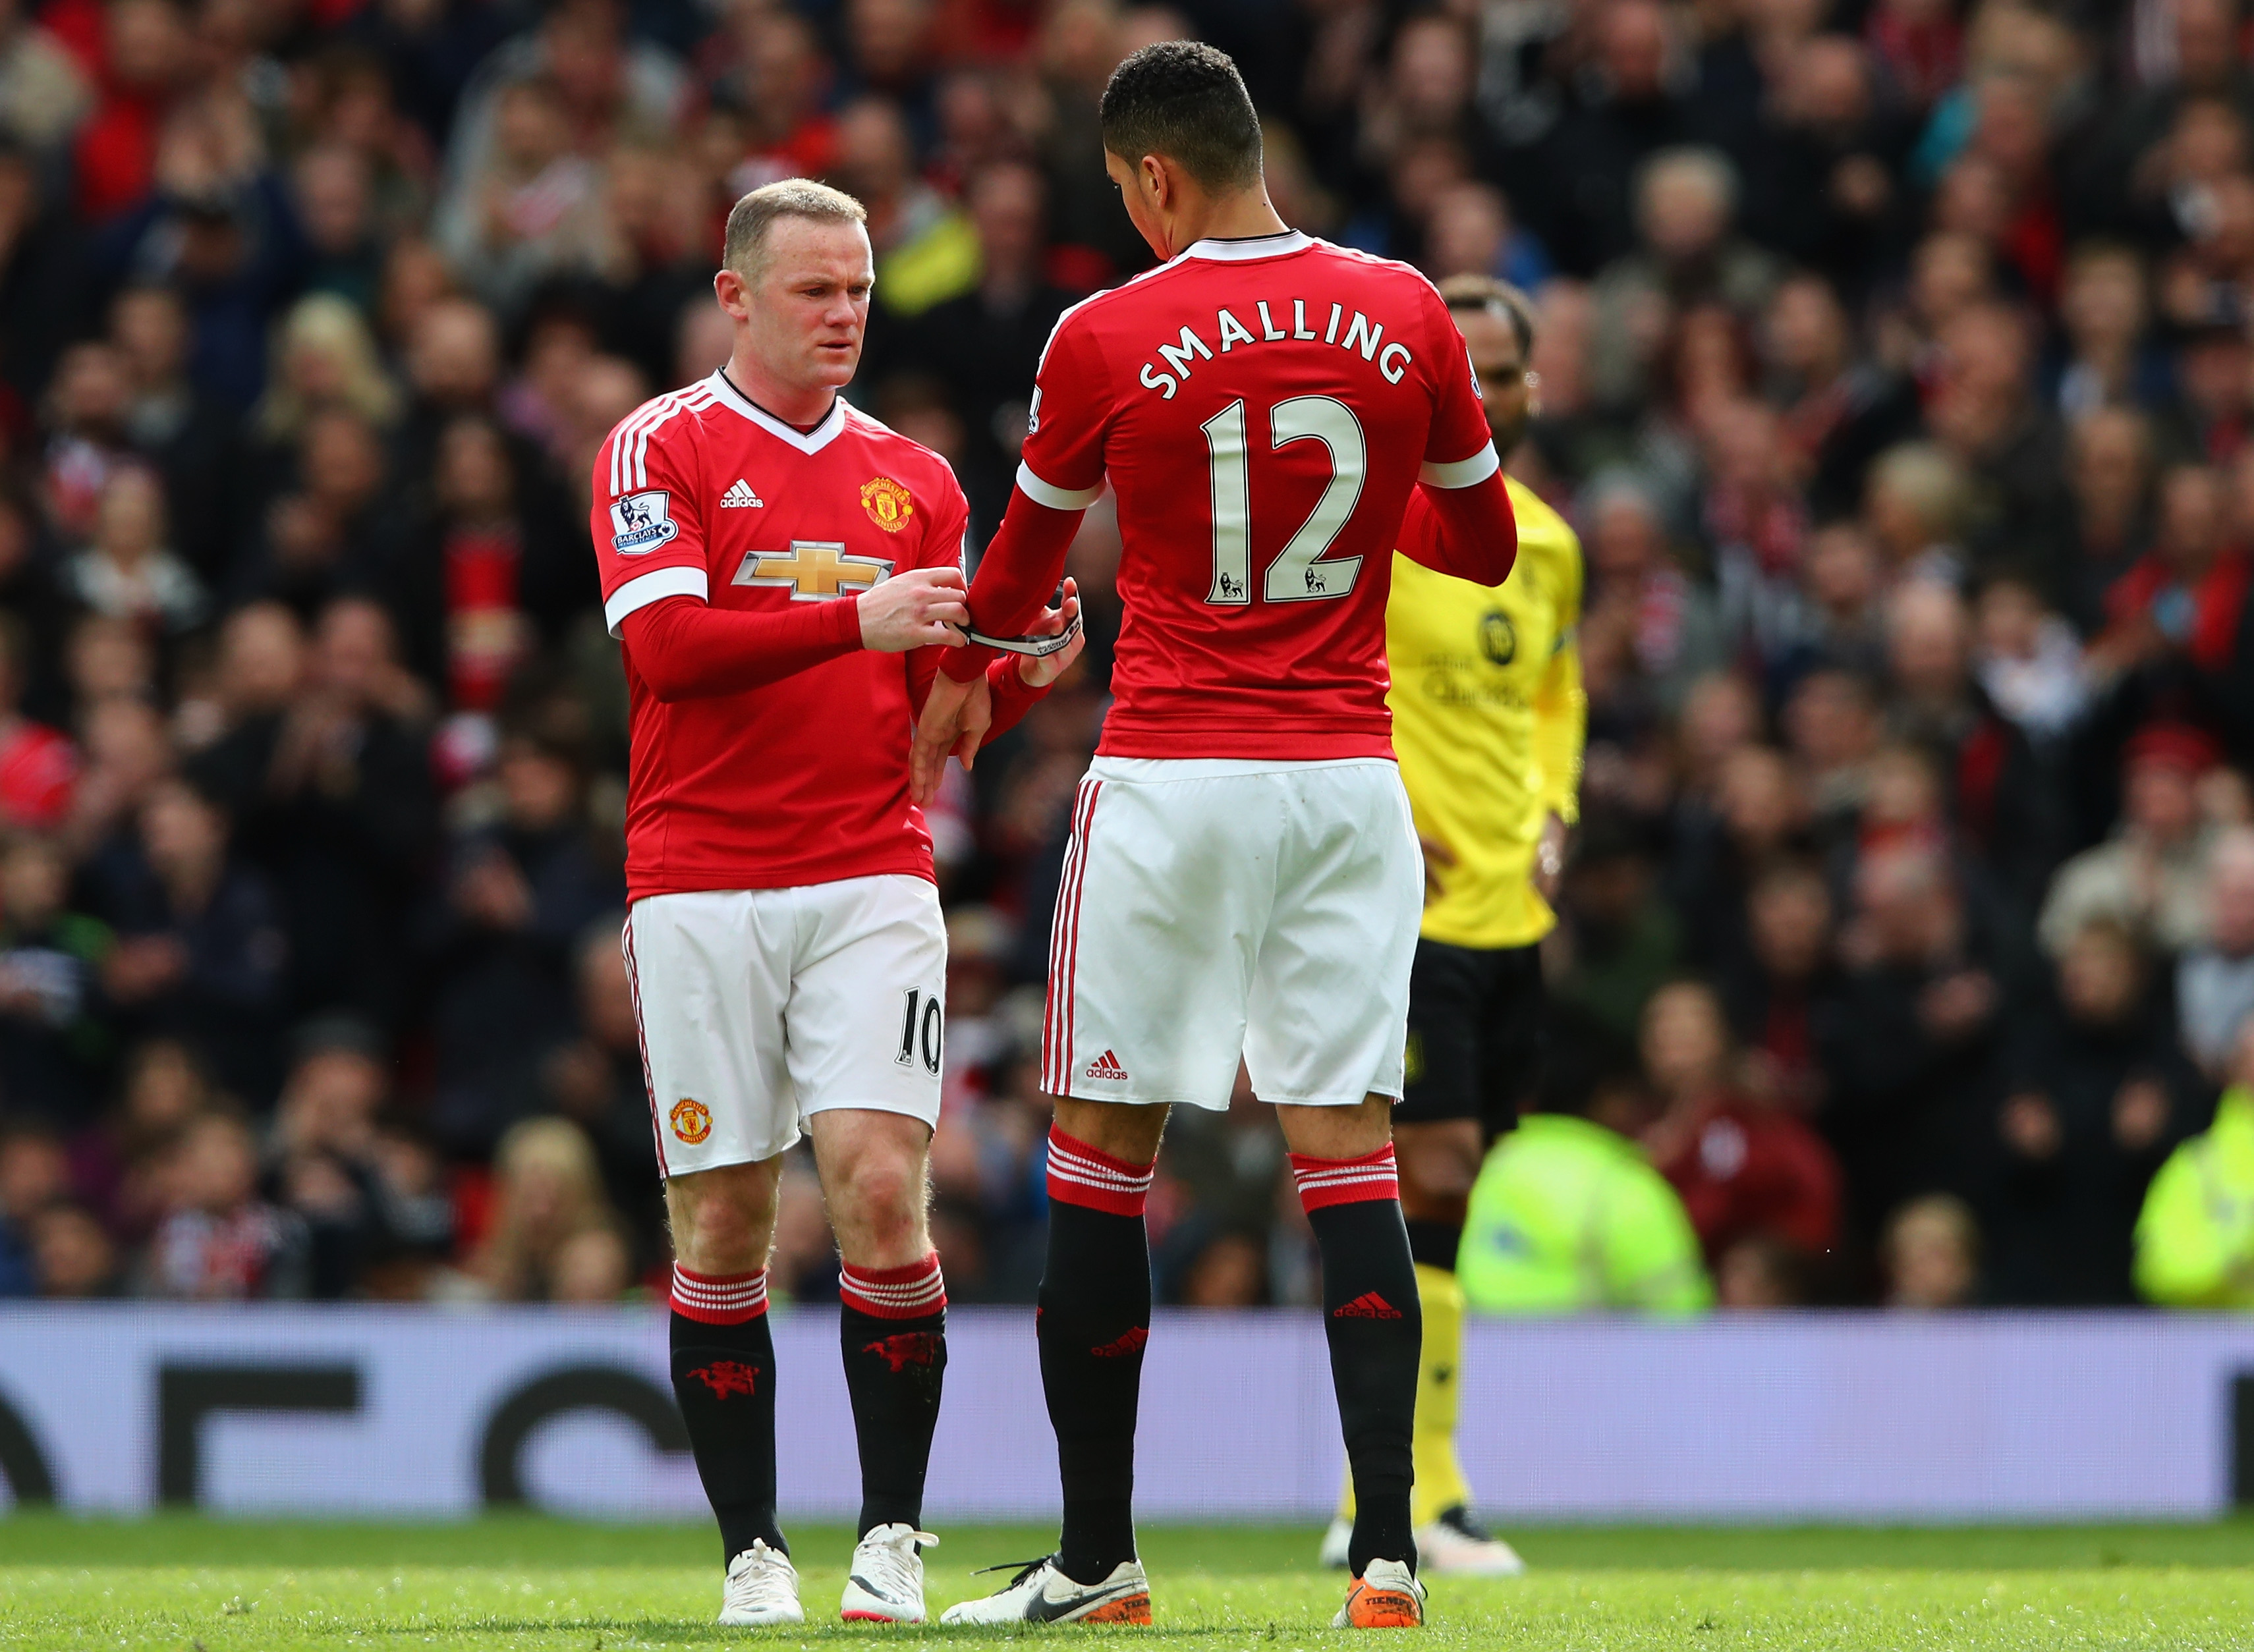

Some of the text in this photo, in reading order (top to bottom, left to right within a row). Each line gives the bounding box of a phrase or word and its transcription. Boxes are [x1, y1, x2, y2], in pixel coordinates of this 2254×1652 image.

[1139, 299, 1412, 400] SMALLING
[720, 497, 764, 509] adidas
[1199, 395, 1368, 607] 12
[617, 526, 657, 544] BARCLAYS
[893, 985, 942, 1077] 10
[1086, 1067, 1128, 1080] adidas
